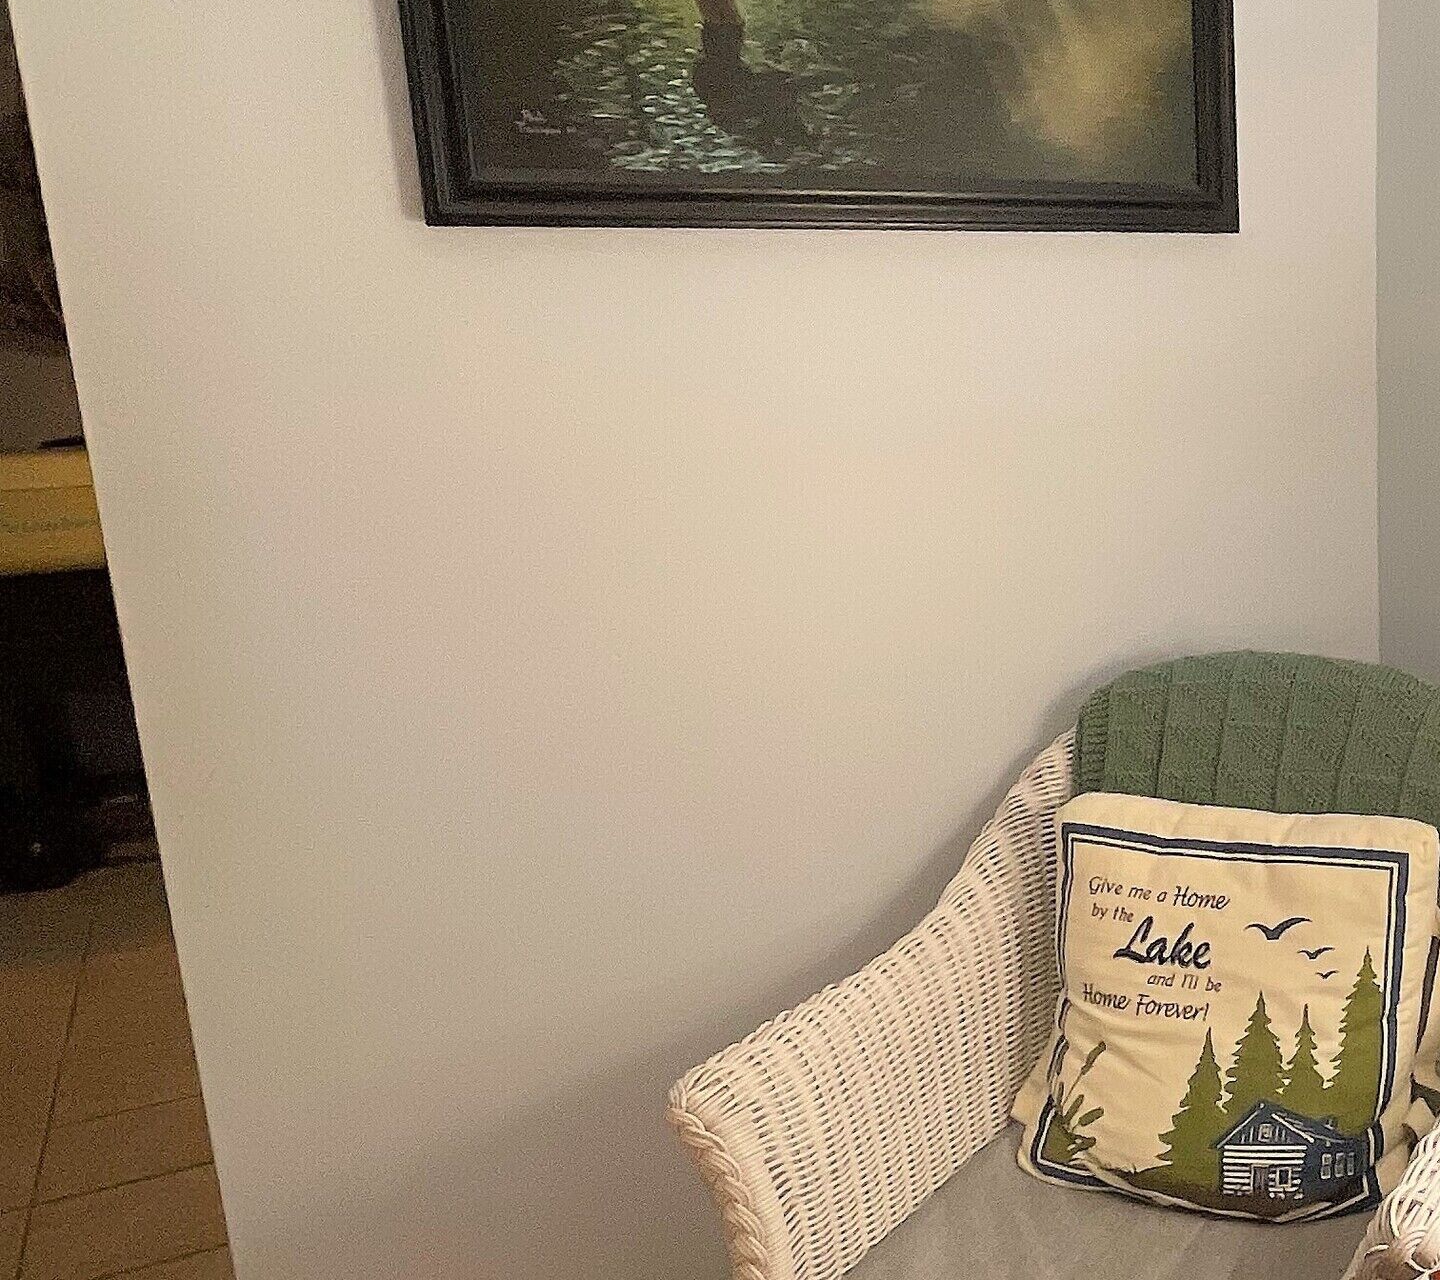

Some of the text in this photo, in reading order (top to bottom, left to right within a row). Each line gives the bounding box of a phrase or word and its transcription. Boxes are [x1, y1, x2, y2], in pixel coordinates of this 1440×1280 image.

[1088, 876, 1231, 910] Give me a Home
[1091, 903, 1134, 922] by the
[1112, 916, 1211, 969] Lake
[1146, 973, 1222, 993] and I'll be
[1082, 983, 1210, 1021] Home Forever!
